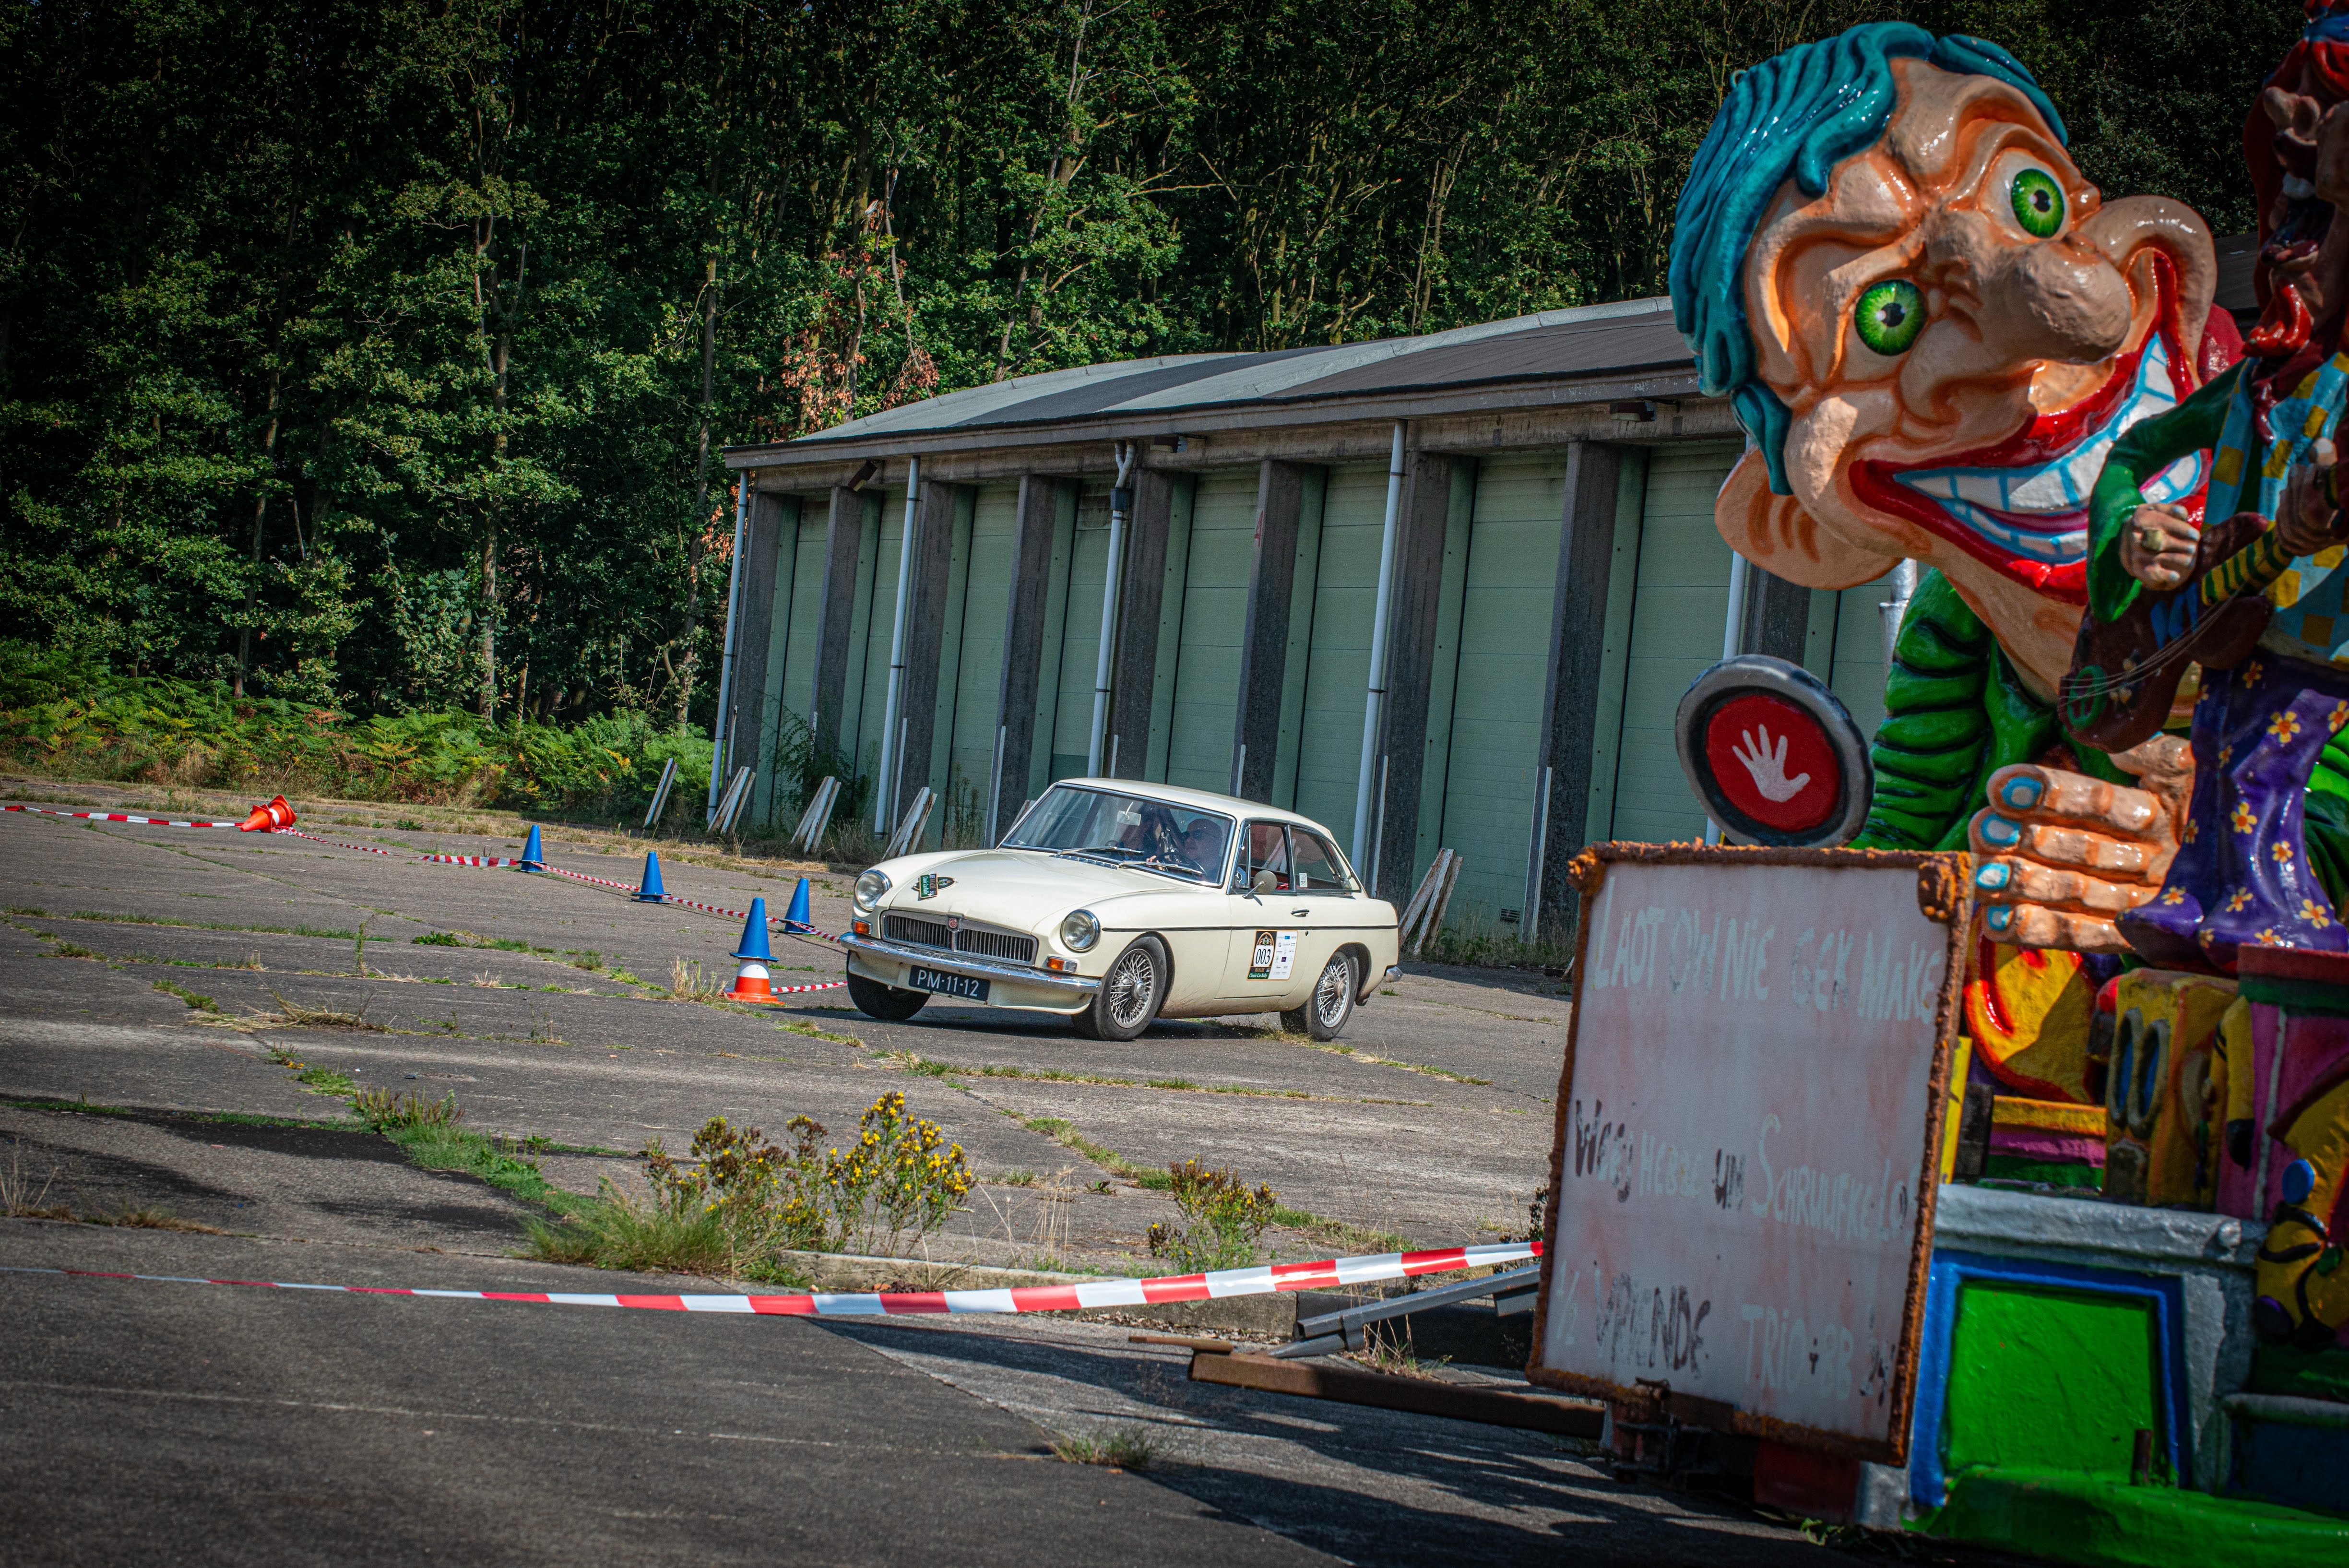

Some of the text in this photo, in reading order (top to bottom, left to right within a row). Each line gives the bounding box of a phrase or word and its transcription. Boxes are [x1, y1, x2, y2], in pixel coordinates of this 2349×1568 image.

[1256, 949, 1271, 964] 003
[1791, 927, 1854, 1011] GEK
[917, 969, 979, 997] PM-11-12
